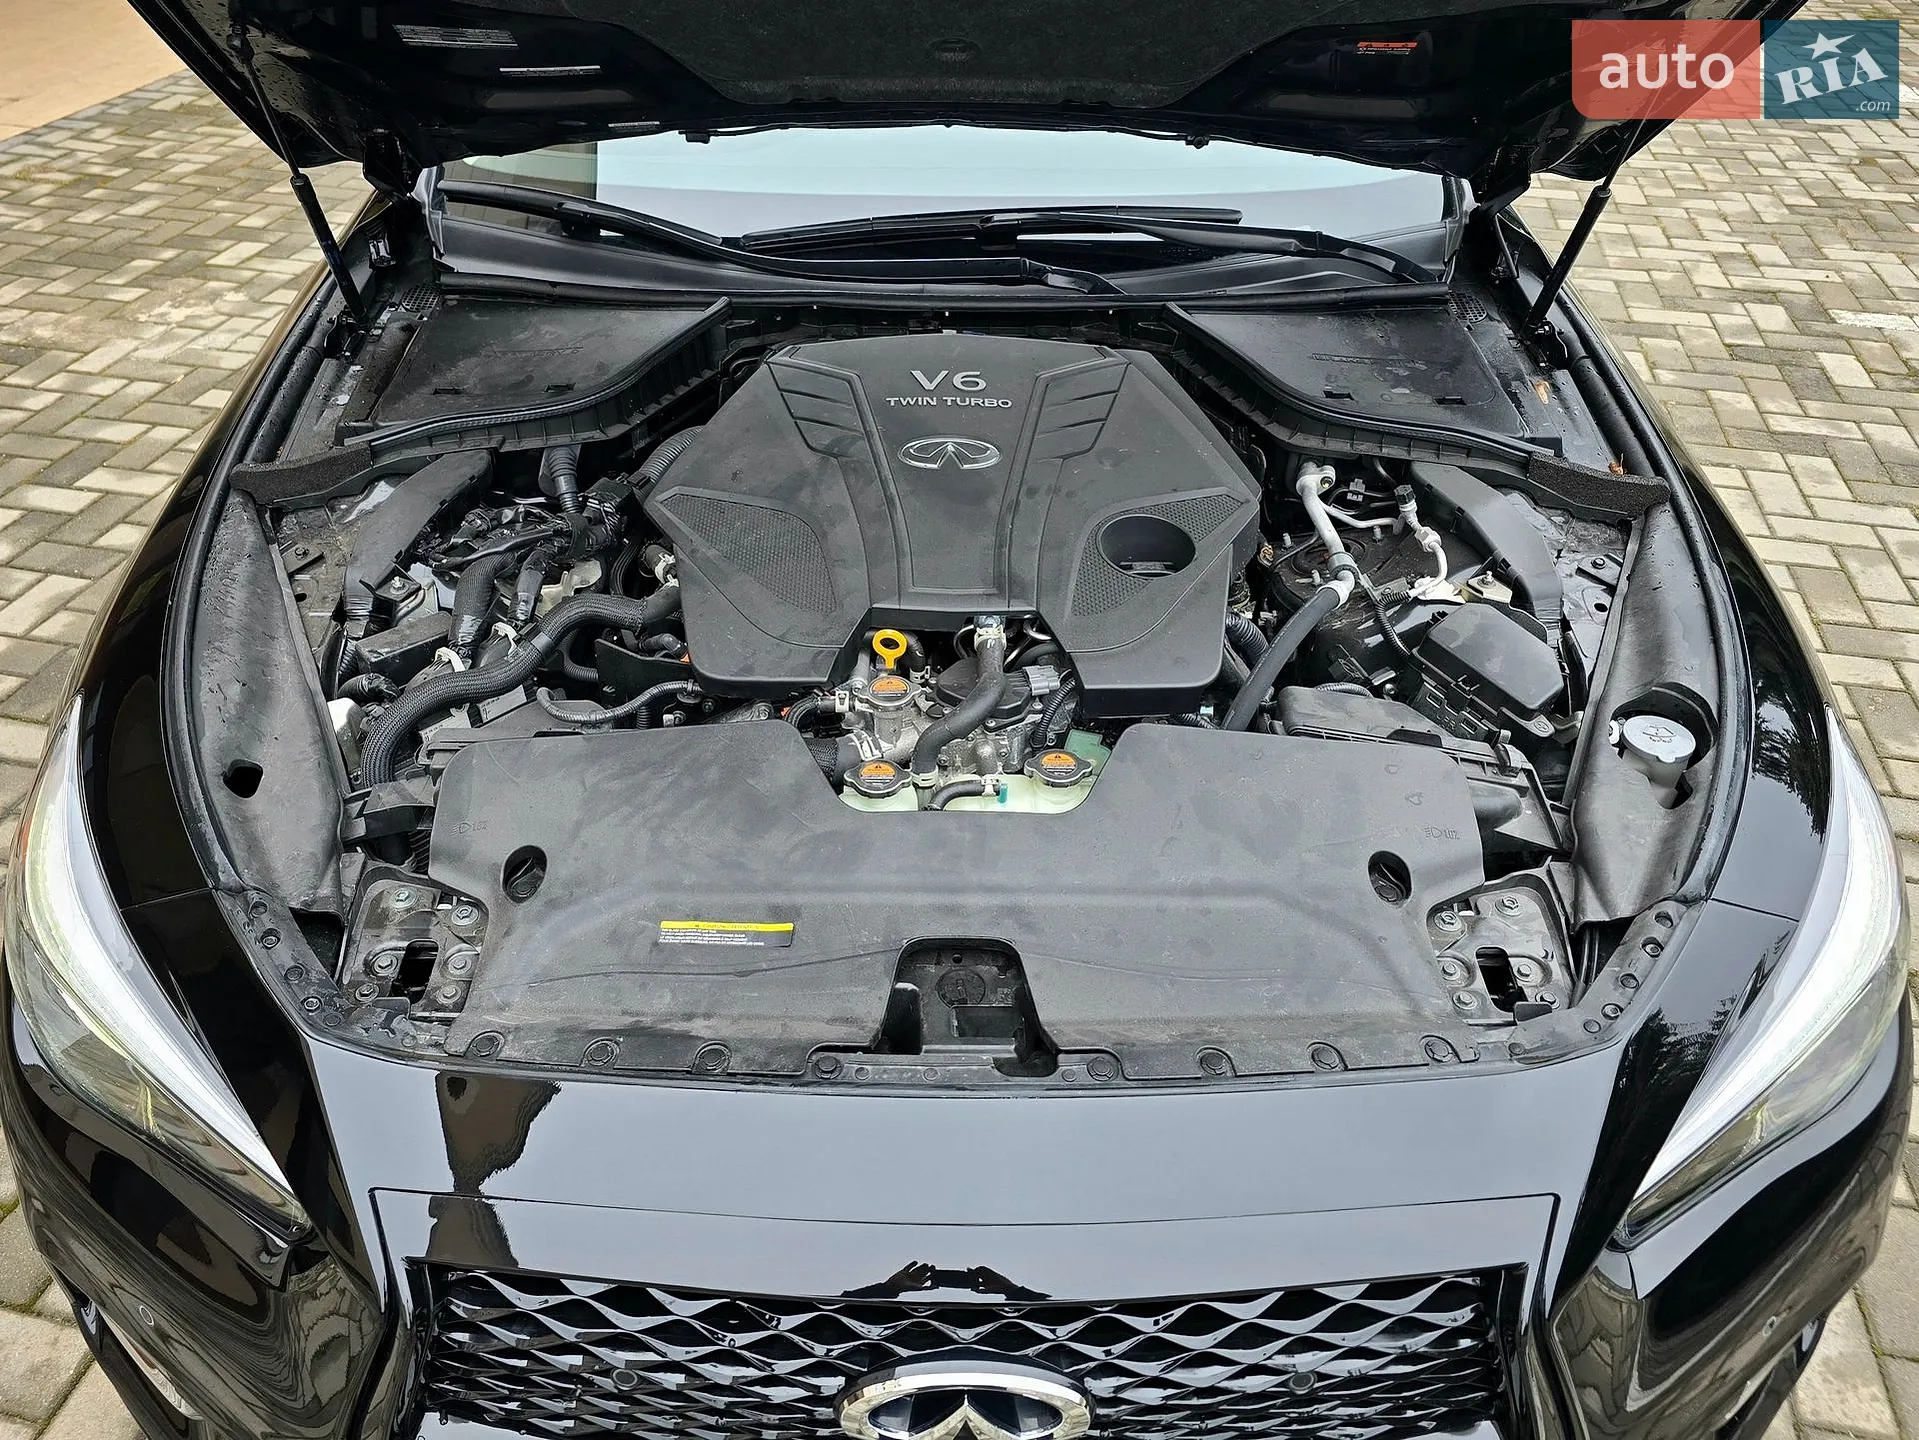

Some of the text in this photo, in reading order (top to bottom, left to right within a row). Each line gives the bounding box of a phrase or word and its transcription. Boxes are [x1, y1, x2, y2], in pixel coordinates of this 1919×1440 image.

[910, 370, 987, 392] V6
[885, 396, 1013, 409] TWIN TURBO
